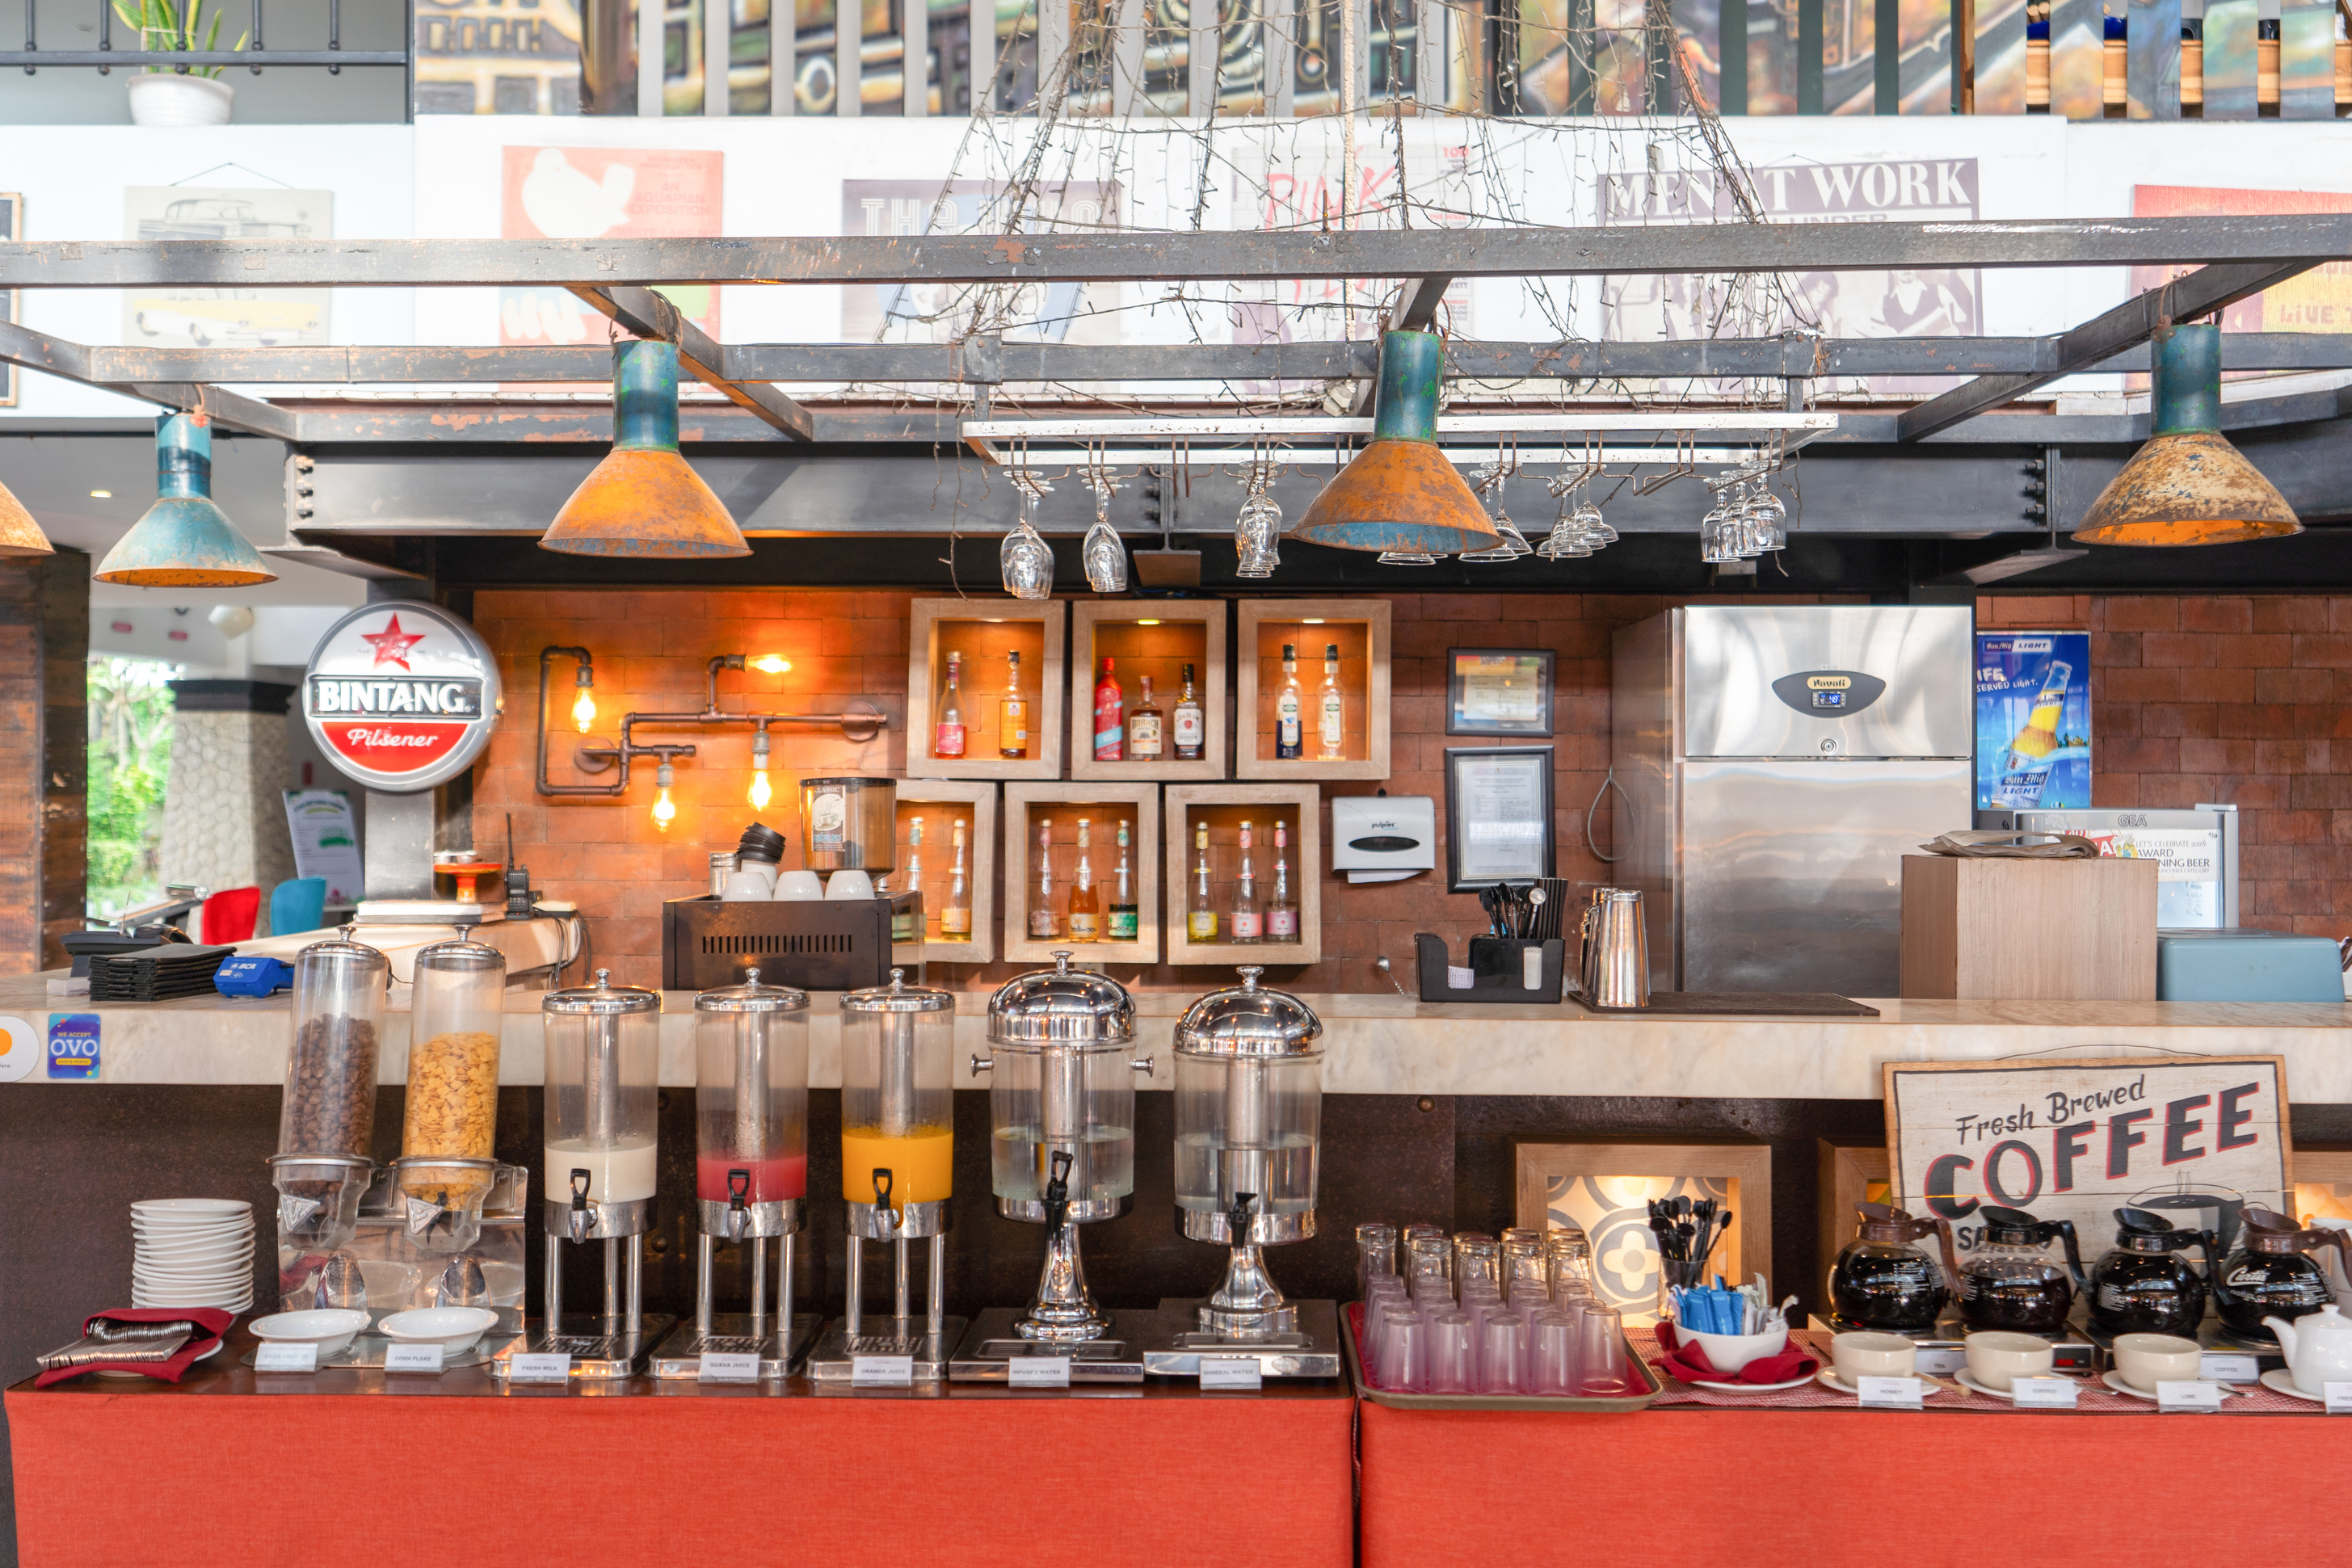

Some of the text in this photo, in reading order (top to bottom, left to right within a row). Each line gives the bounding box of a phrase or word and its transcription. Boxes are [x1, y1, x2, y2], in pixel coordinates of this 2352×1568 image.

[661, 182, 680, 192] AN
[1609, 173, 1715, 217] MEN
[1809, 161, 1973, 209] WORK
[634, 192, 705, 204] AQUARIAN
[628, 204, 709, 216] EXPOSITION
[1977, 667, 2007, 682] IFE.
[1977, 681, 2010, 693] SERVED
[318, 682, 468, 713] BINTANG
[347, 728, 439, 747] Pilsener
[1371, 821, 1395, 830] pulpies
[2118, 814, 2147, 827] GEA
[2191, 839, 2207, 847] with
[2138, 848, 2174, 857] AWARD
[2158, 859, 2210, 868] NING BEER
[50, 1039, 98, 1057] OVO
[1955, 1074, 2147, 1146] Fresh Brewed
[1924, 1082, 2260, 1221] COFFEE
[2226, 1267, 2271, 1287] Curtis
